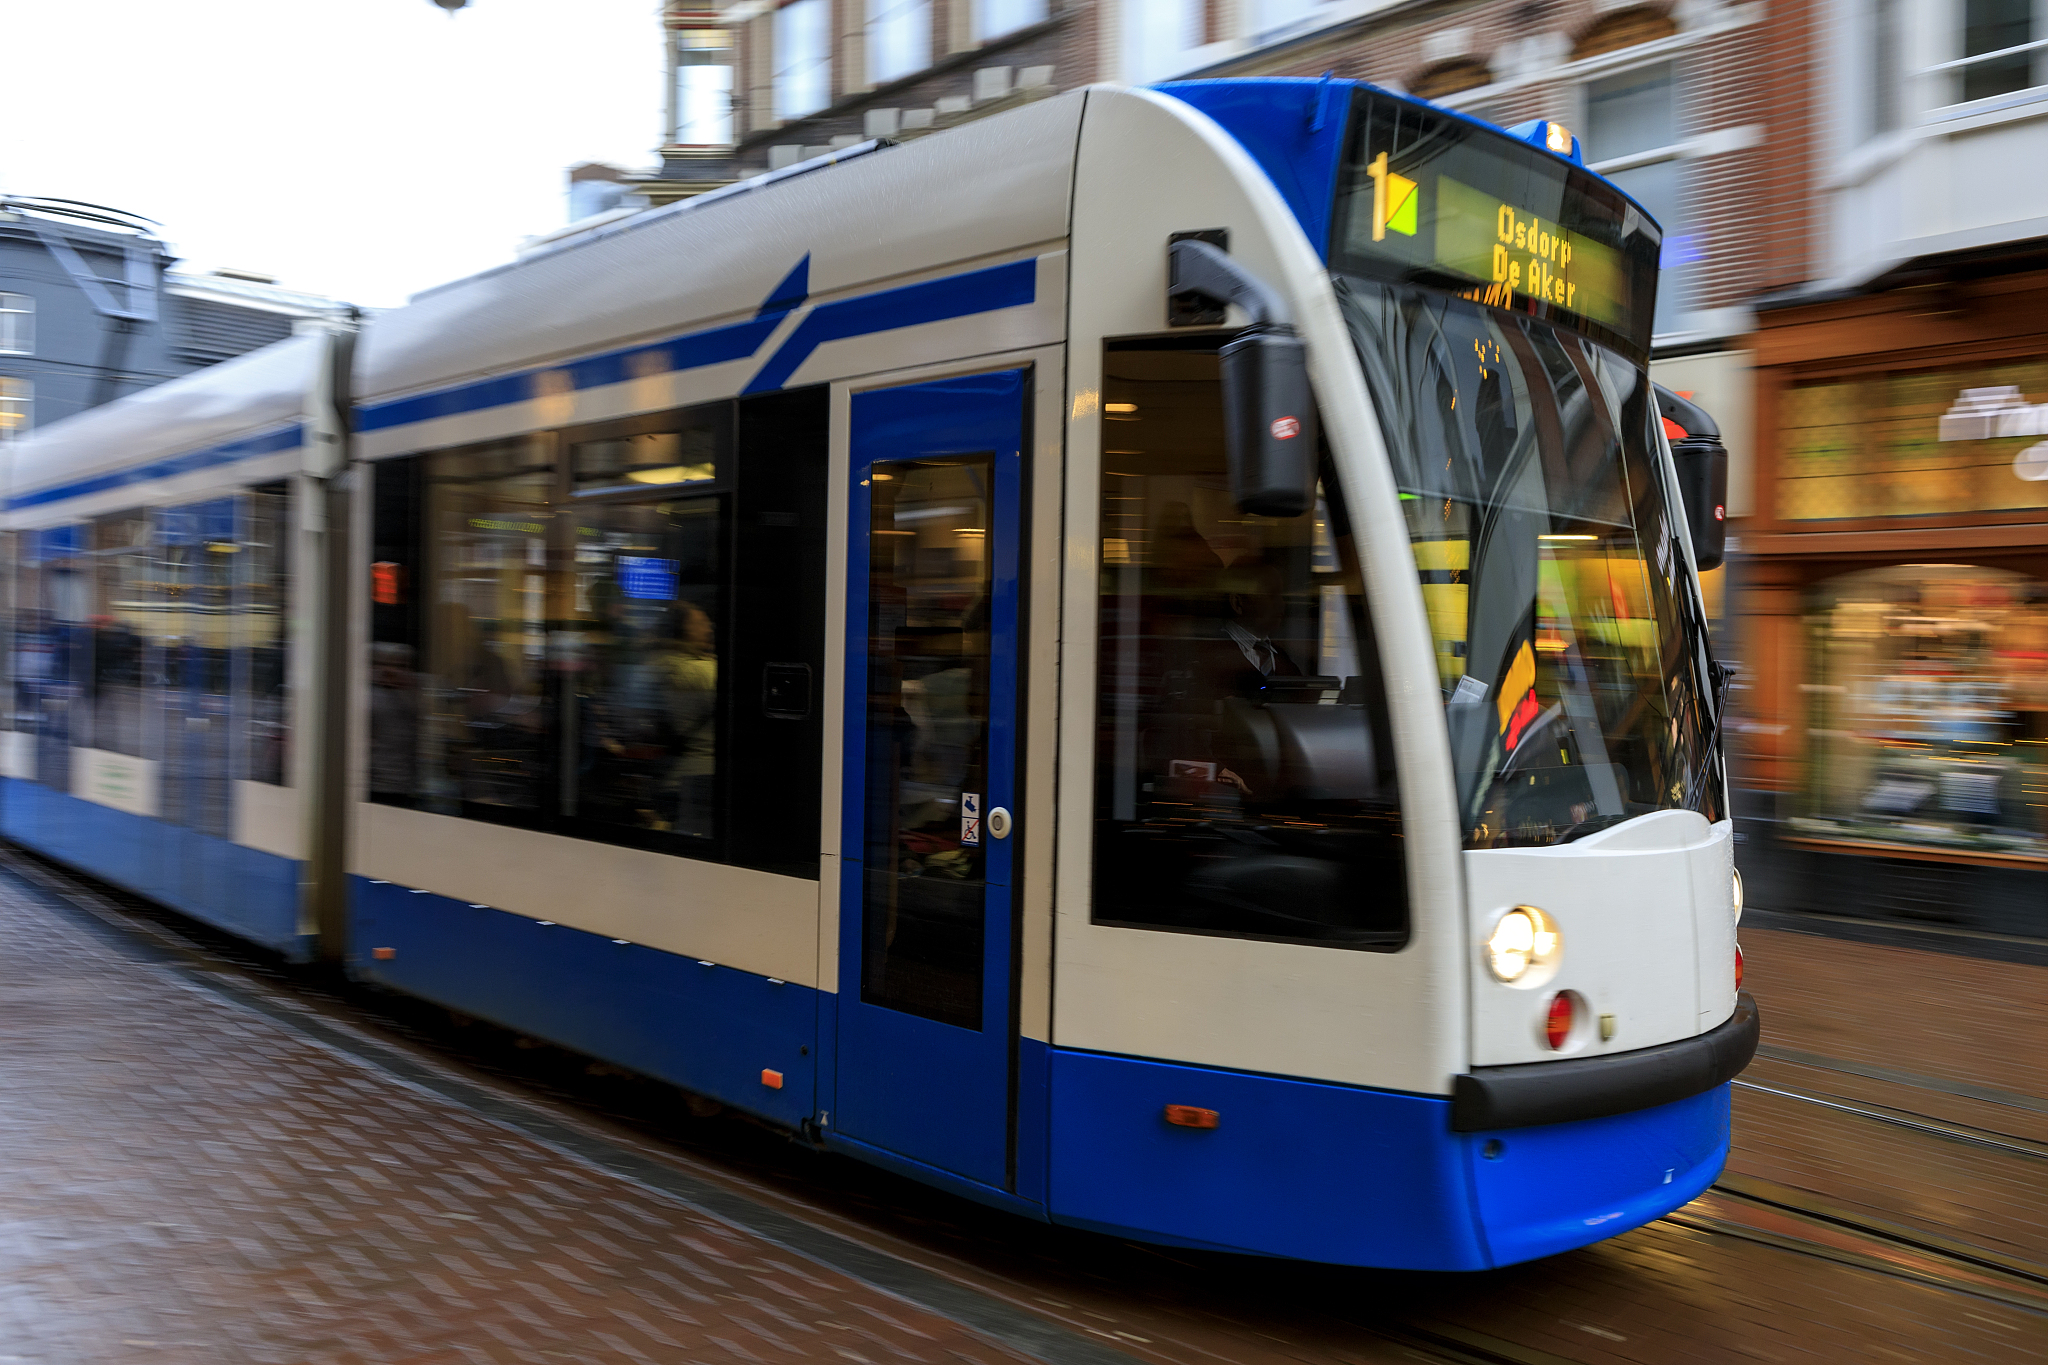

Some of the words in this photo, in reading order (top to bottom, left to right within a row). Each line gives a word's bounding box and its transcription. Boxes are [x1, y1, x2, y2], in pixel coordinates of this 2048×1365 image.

[1366, 151, 1388, 242] 1
[1498, 204, 1571, 268] Osdorp
[1493, 243, 1520, 287] De
[1528, 258, 1575, 307] Aker
